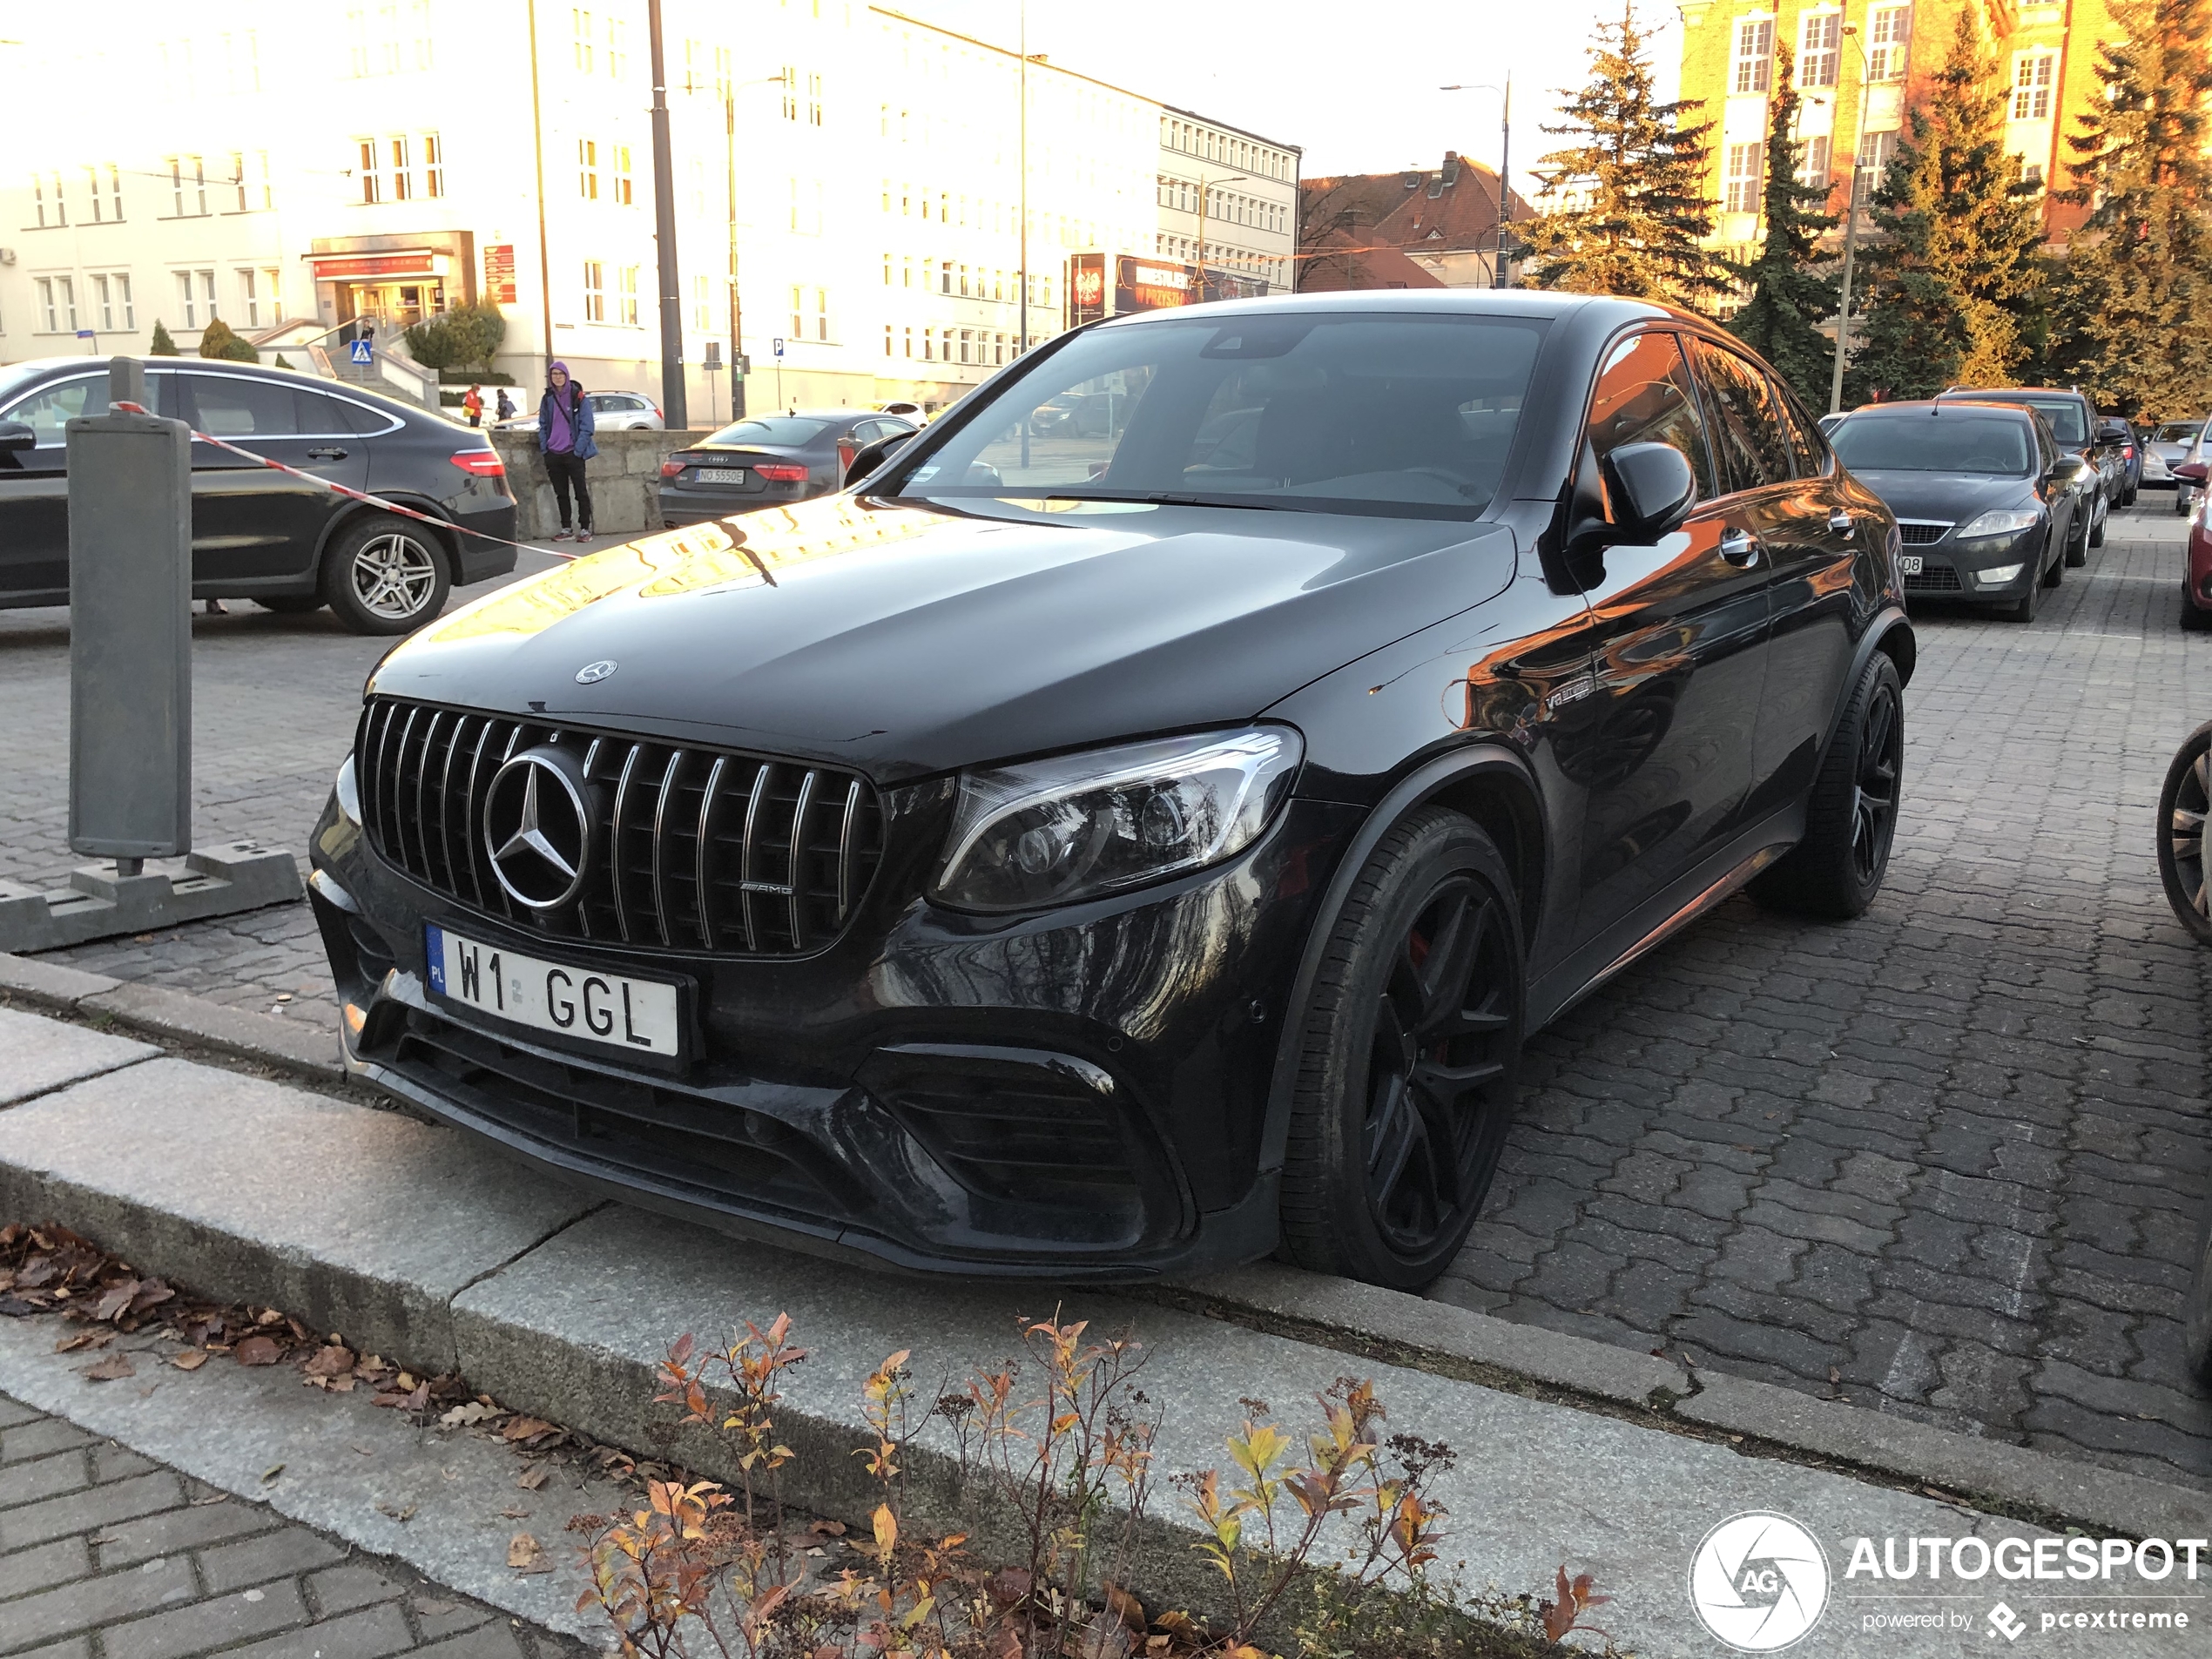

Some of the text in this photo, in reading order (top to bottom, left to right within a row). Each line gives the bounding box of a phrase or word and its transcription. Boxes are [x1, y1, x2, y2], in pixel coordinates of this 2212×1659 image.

[1136, 287, 1144, 303] W
[775, 339, 783, 354] P
[699, 469, 713, 480] NO
[717, 470, 742, 482] 5550E
[756, 884, 793, 895] AMG
[431, 965, 444, 983] PL
[458, 941, 651, 1048] W1 GGL
